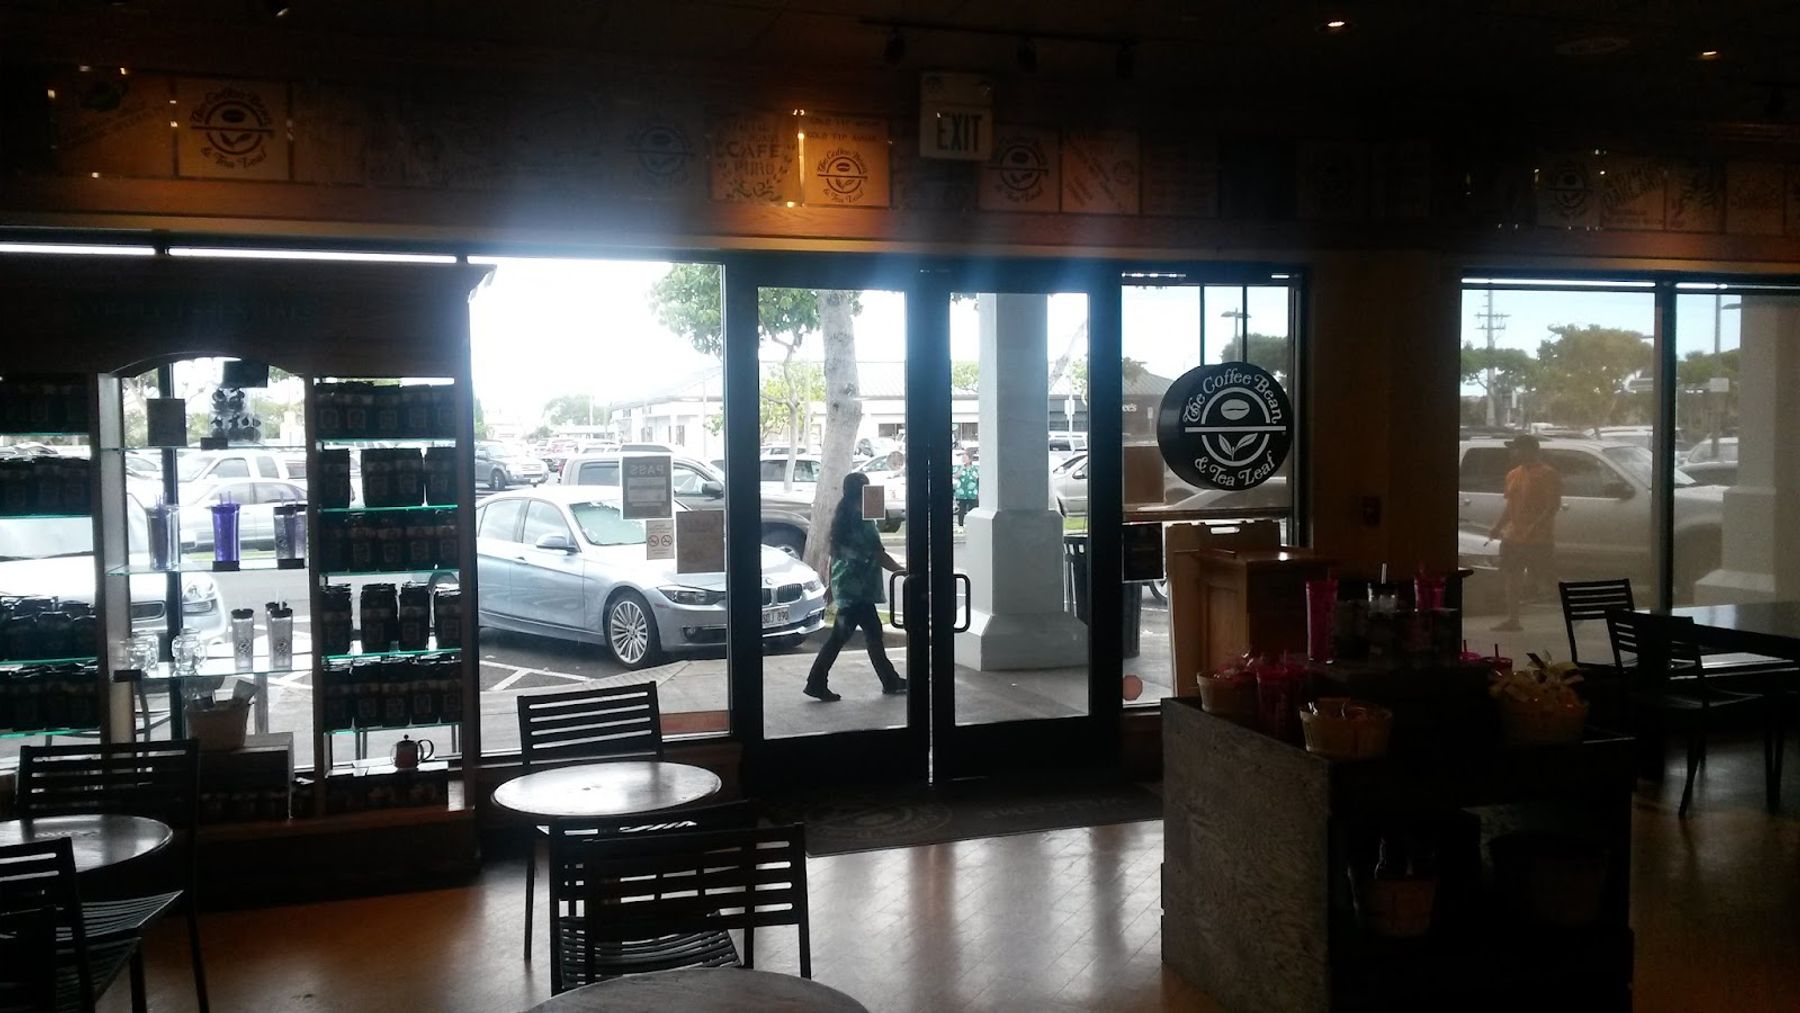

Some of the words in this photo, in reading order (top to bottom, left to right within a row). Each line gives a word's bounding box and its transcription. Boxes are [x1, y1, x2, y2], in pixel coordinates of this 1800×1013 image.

[725, 141, 781, 159] CAFE
[936, 112, 983, 152] EXIT
[1183, 393, 1206, 423] The
[1203, 368, 1252, 393] Coffee
[1253, 373, 1283, 424] Bean
[1194, 456, 1207, 474] &
[1209, 464, 1236, 487] Tea
[1237, 450, 1277, 487] Leaf
